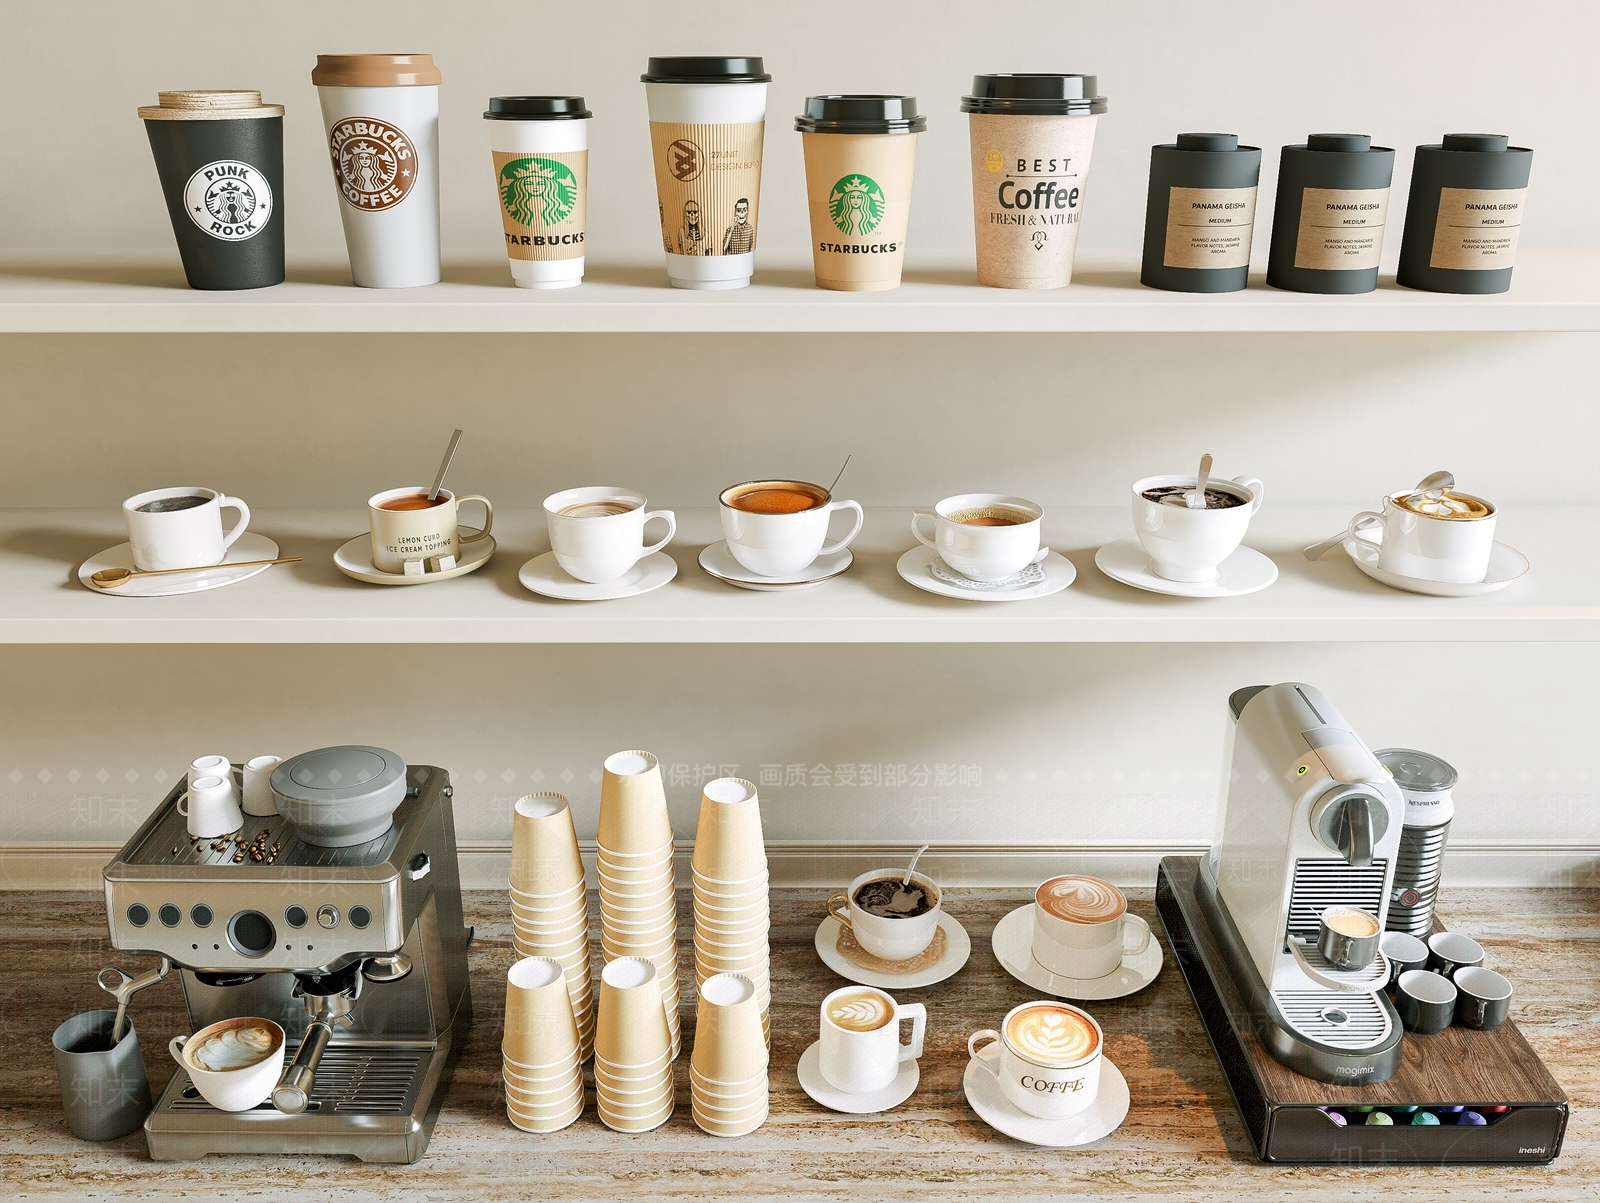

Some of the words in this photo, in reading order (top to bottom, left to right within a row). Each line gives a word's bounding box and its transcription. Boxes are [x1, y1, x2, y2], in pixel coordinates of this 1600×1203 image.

[331, 122, 411, 160] STARBUCKS
[711, 161, 741, 170] DESIGN
[1017, 158, 1071, 172] BEST
[204, 165, 250, 181] PUNK
[342, 183, 403, 206] COFFEE
[998, 180, 1079, 210] Coffee
[990, 212, 1025, 226] FRESH
[1028, 215, 1037, 226] &
[210, 220, 256, 236] ROCK
[820, 242, 897, 254] STARBUCKS
[426, 538, 450, 551] TOPPING
[1336, 1065, 1374, 1076] magimix
[1020, 1076, 1084, 1094] COFFE
